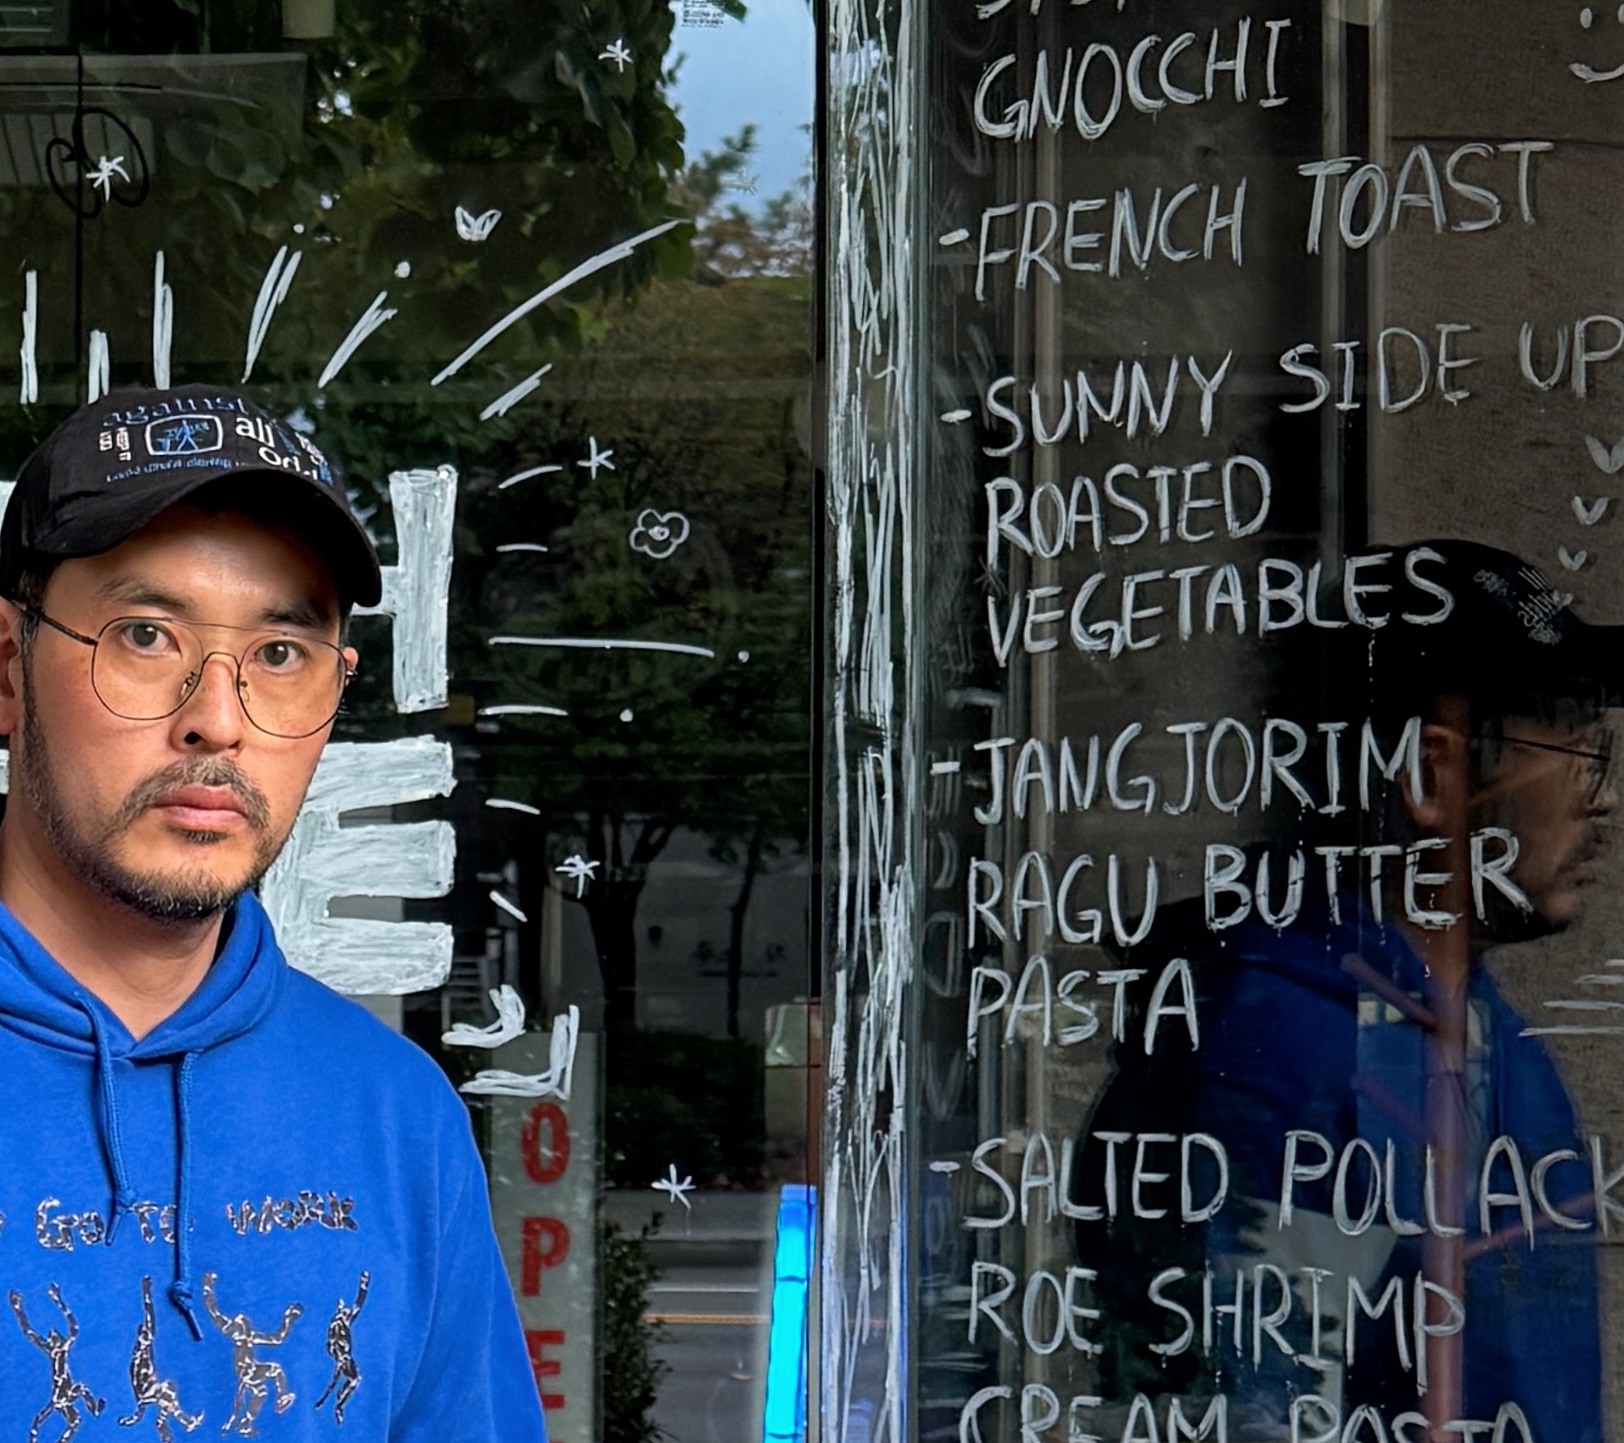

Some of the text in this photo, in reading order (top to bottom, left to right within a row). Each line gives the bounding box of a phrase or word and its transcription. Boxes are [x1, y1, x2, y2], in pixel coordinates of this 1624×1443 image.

[974, 16, 1291, 143] GNOCCHI
[1297, 140, 1554, 254] TOAST
[1278, 323, 1477, 414] SIDE
[1519, 315, 1624, 400] UP
[984, 455, 1272, 570] ROASTED
[987, 546, 1456, 667] VEGETABLES
[968, 827, 1533, 948] RAGU BUTTER
[968, 954, 1200, 1054] PASTA
[968, 1260, 1465, 1396] ROE SHRIMP
